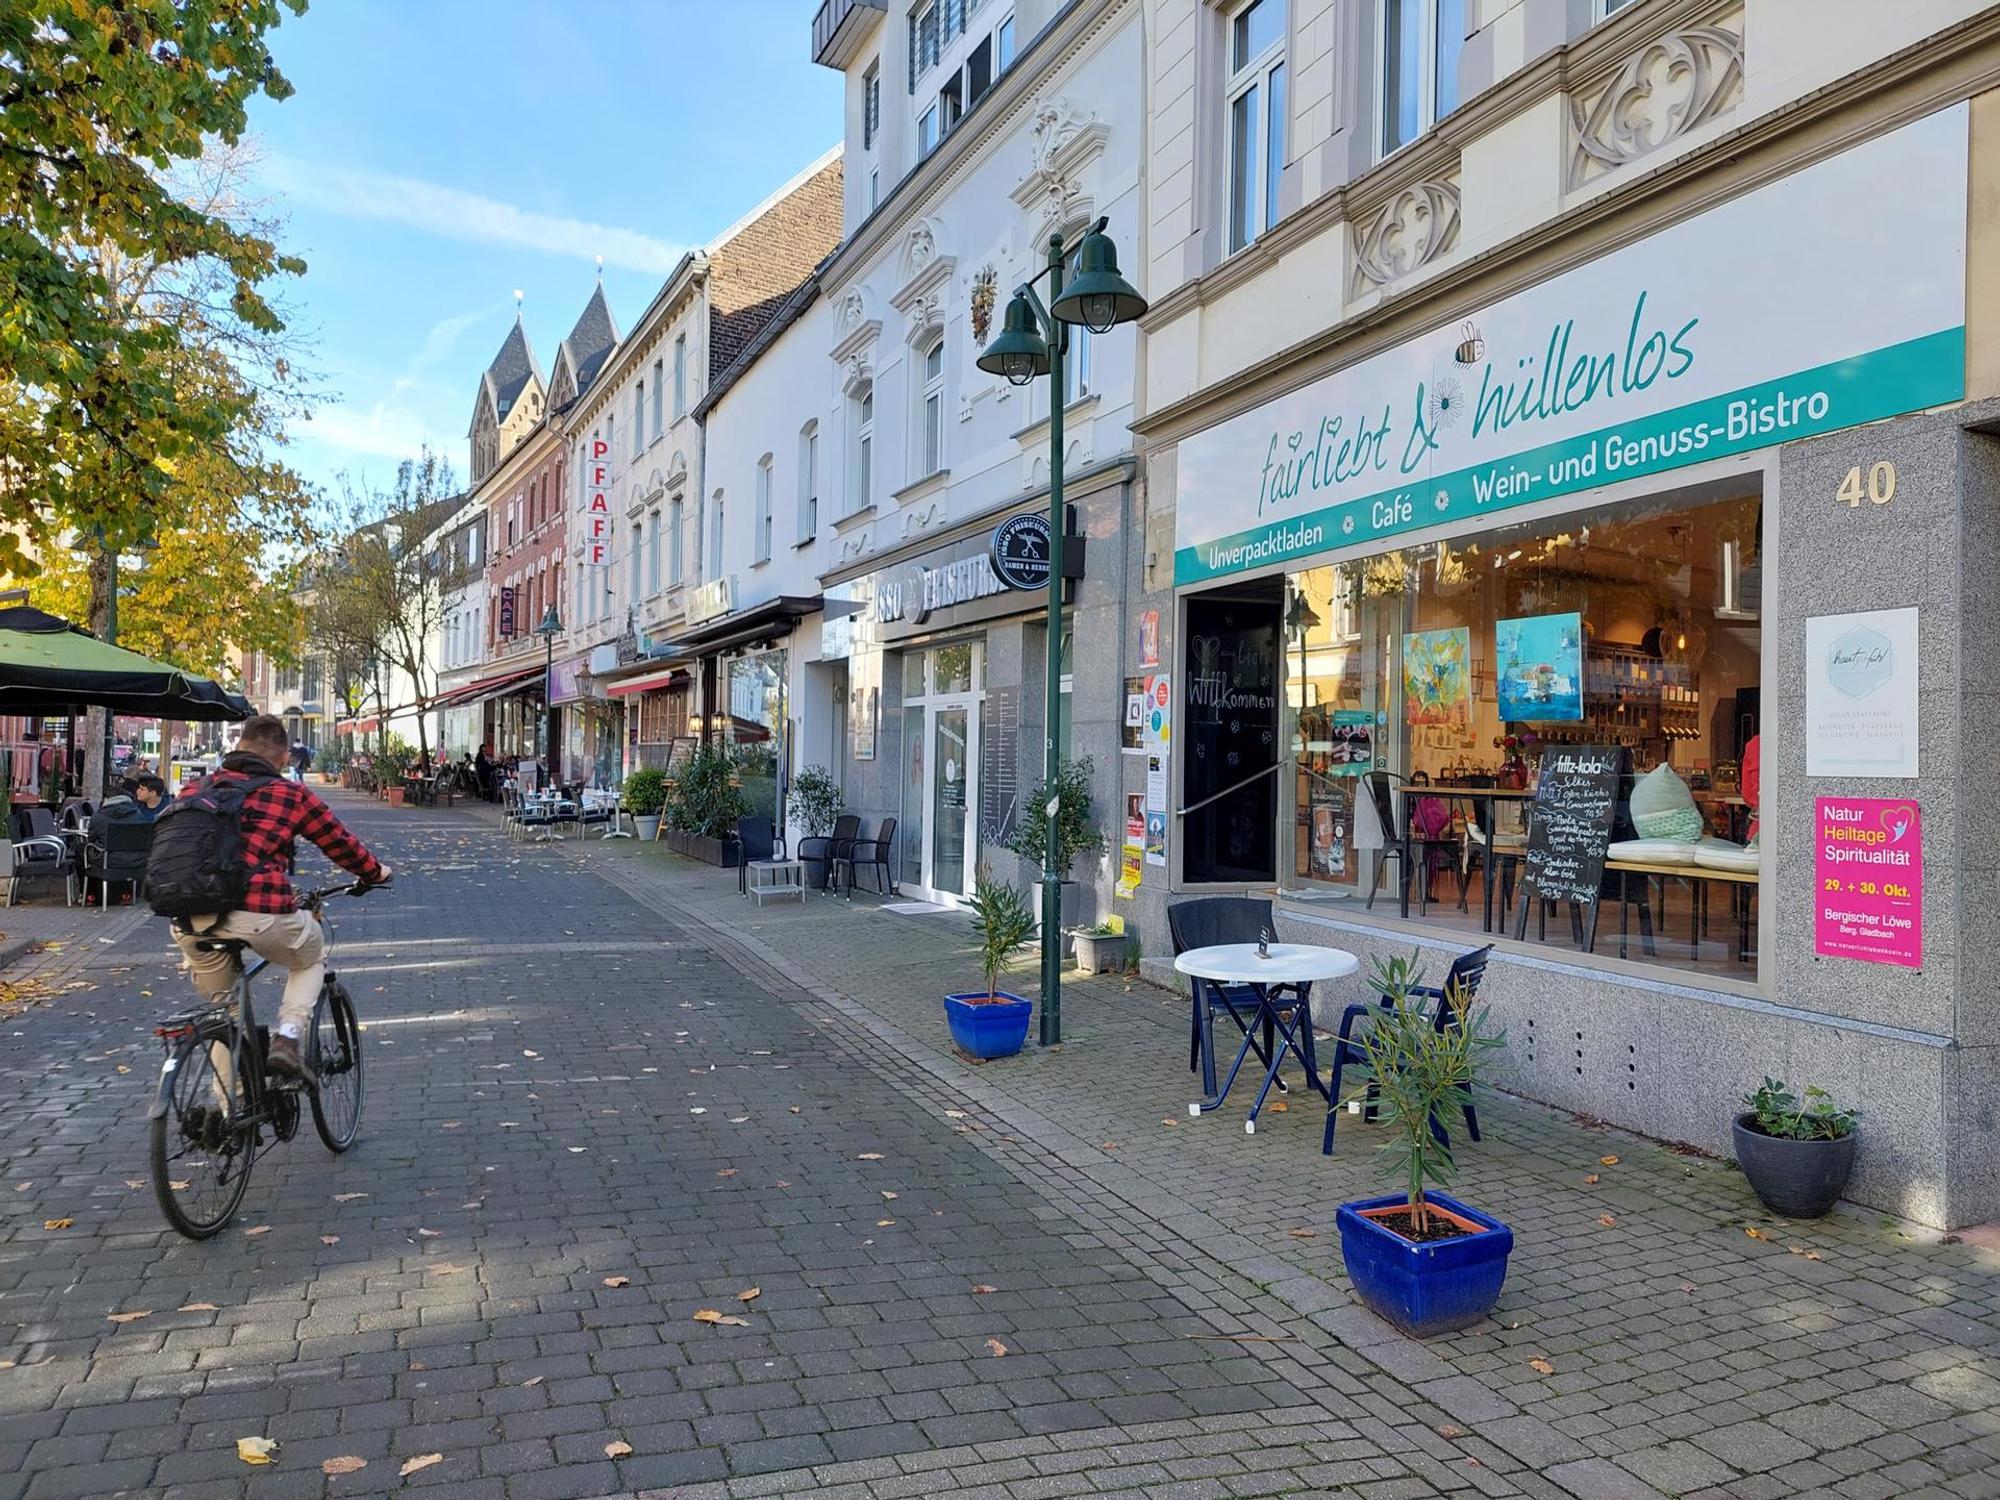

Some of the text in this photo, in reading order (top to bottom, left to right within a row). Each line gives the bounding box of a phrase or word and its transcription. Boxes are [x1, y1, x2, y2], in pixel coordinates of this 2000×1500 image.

[1257, 290, 1699, 517] fairliebt & hüllenlos
[1208, 391, 1829, 570] Unverpacktladen Café Wein- und Genuss-Bistro
[1836, 460, 1897, 508] 40
[591, 440, 609, 564] PFAFF
[502, 590, 513, 633] CAFE
[1188, 669, 1276, 709] Willkommen
[1557, 754, 1602, 774] fritz-kola
[1824, 805, 1864, 822] Natur
[1824, 825, 1887, 846] Heiltage
[1825, 845, 1911, 866] Spiritualität
[1824, 878, 1844, 892] 29.
[1859, 881, 1880, 895] 30.
[1883, 883, 1911, 898] Okt.
[1824, 908, 1912, 929] Bergischer Löwe
[1840, 925, 1895, 939] Berg. Gladbach
